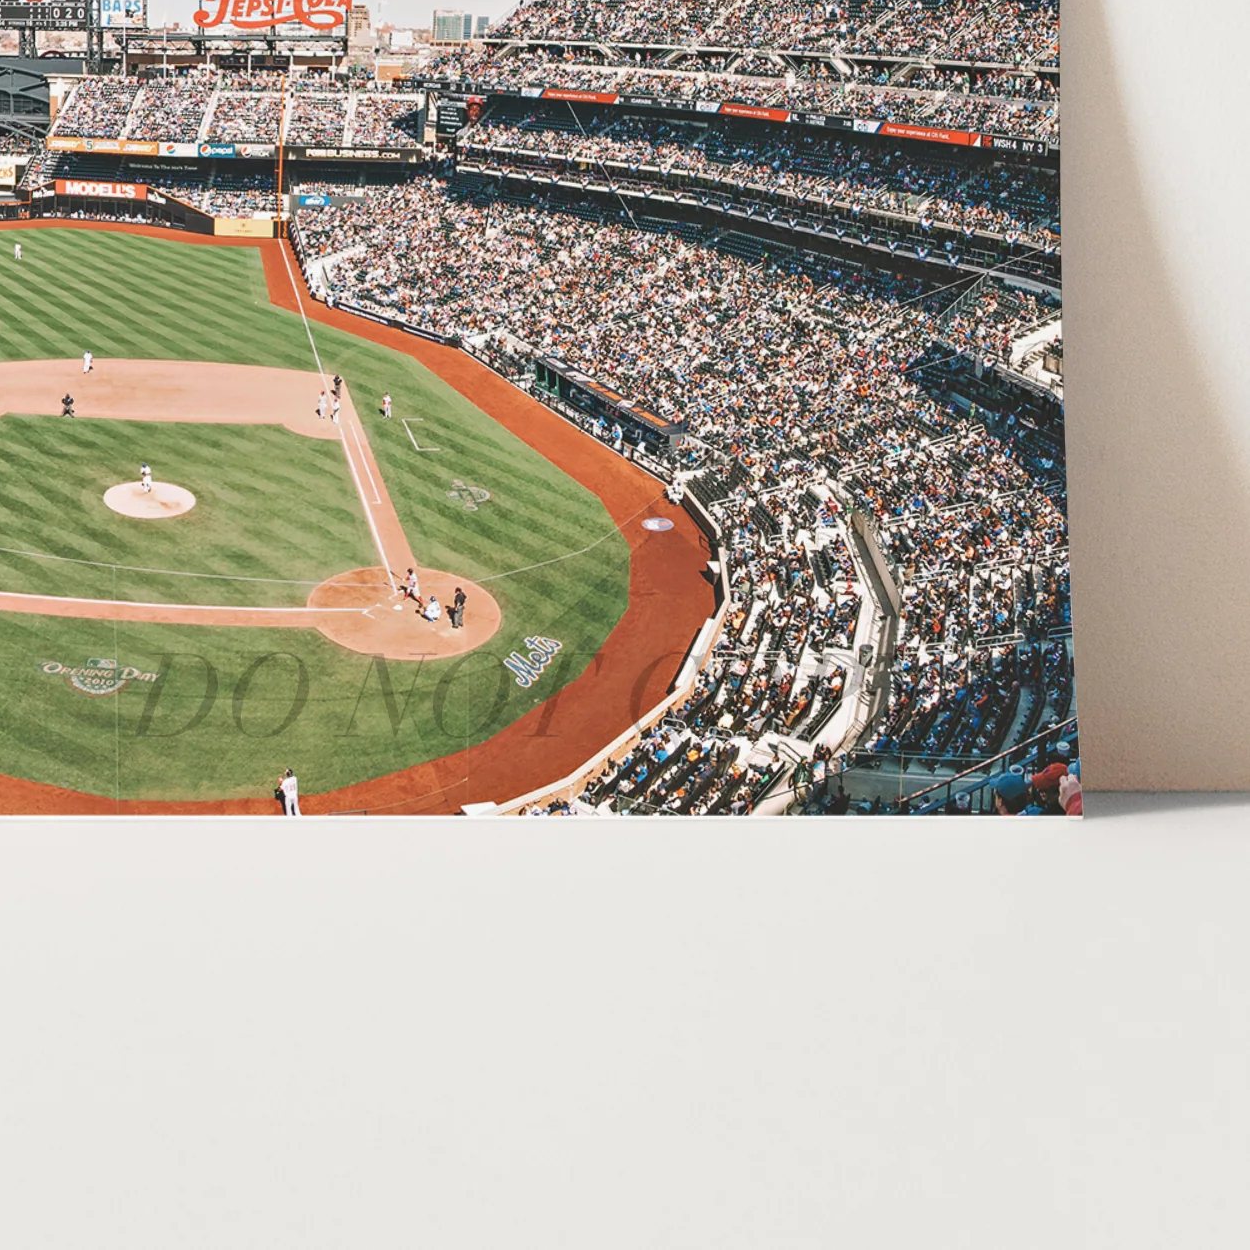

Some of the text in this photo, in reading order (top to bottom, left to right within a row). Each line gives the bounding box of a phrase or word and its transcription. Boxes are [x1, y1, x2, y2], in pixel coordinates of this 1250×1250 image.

[102, 0, 141, 12] BARS
[886, 126, 897, 134] Enjoy
[906, 129, 926, 138] experience
[211, 147, 233, 156] pepsi
[993, 138, 1043, 153] WSH 4 NY 3
[65, 181, 137, 198] MODELL'S
[503, 635, 564, 688] Mets
[84, 678, 114, 686] 2010
